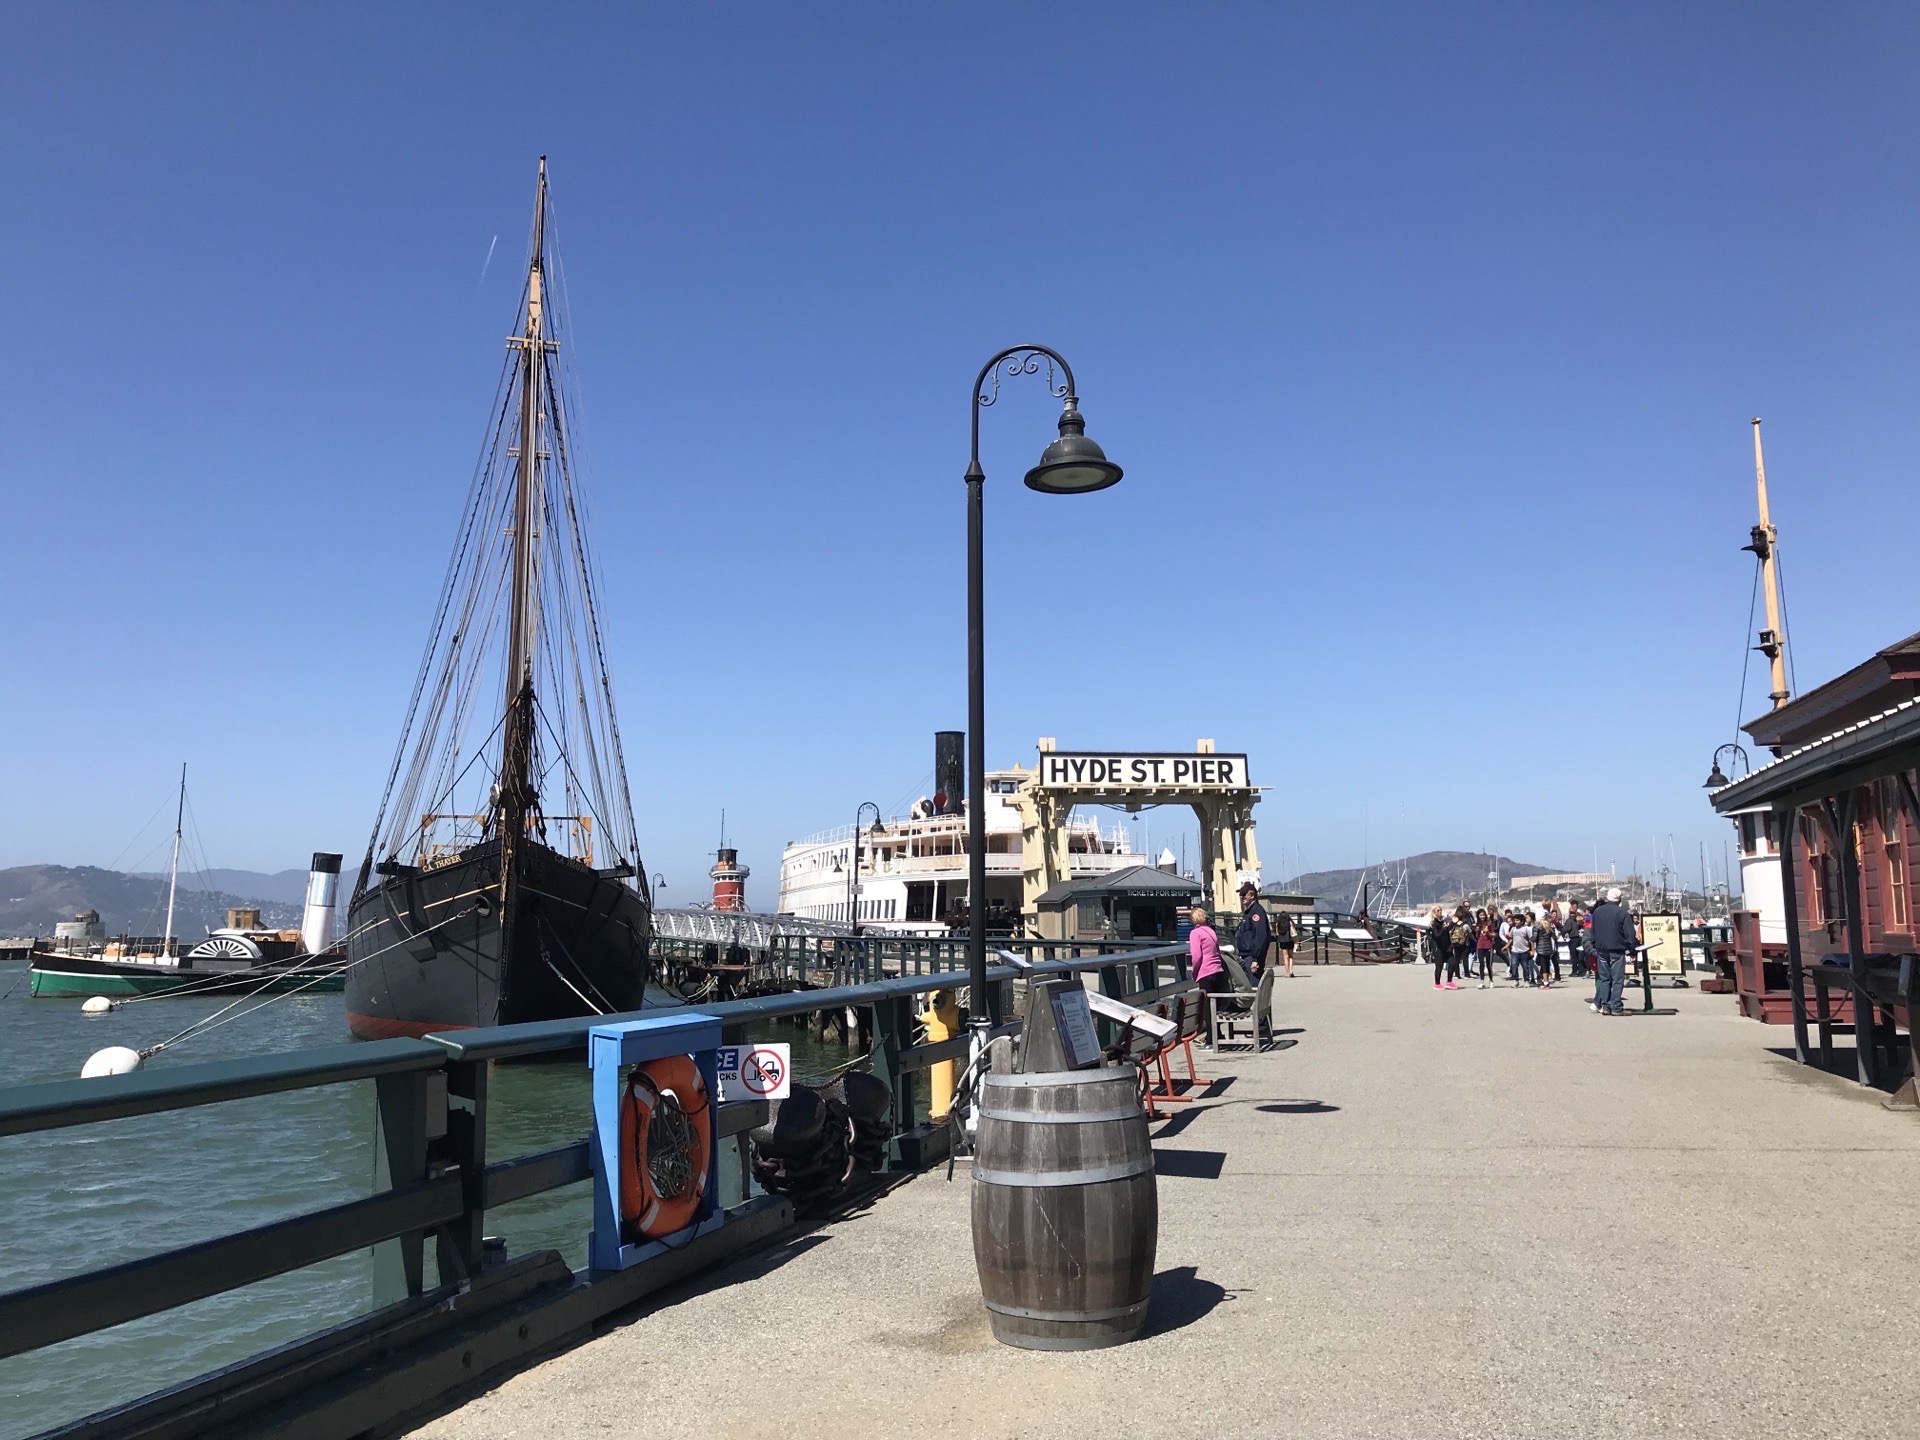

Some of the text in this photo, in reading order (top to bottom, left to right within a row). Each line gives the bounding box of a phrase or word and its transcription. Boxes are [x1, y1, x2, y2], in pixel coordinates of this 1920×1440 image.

[1051, 758, 1233, 783] HYDE ST. PIER
[434, 854, 462, 869] THAYER
[1126, 889, 1191, 897] TICKETS FOR SHIPS
